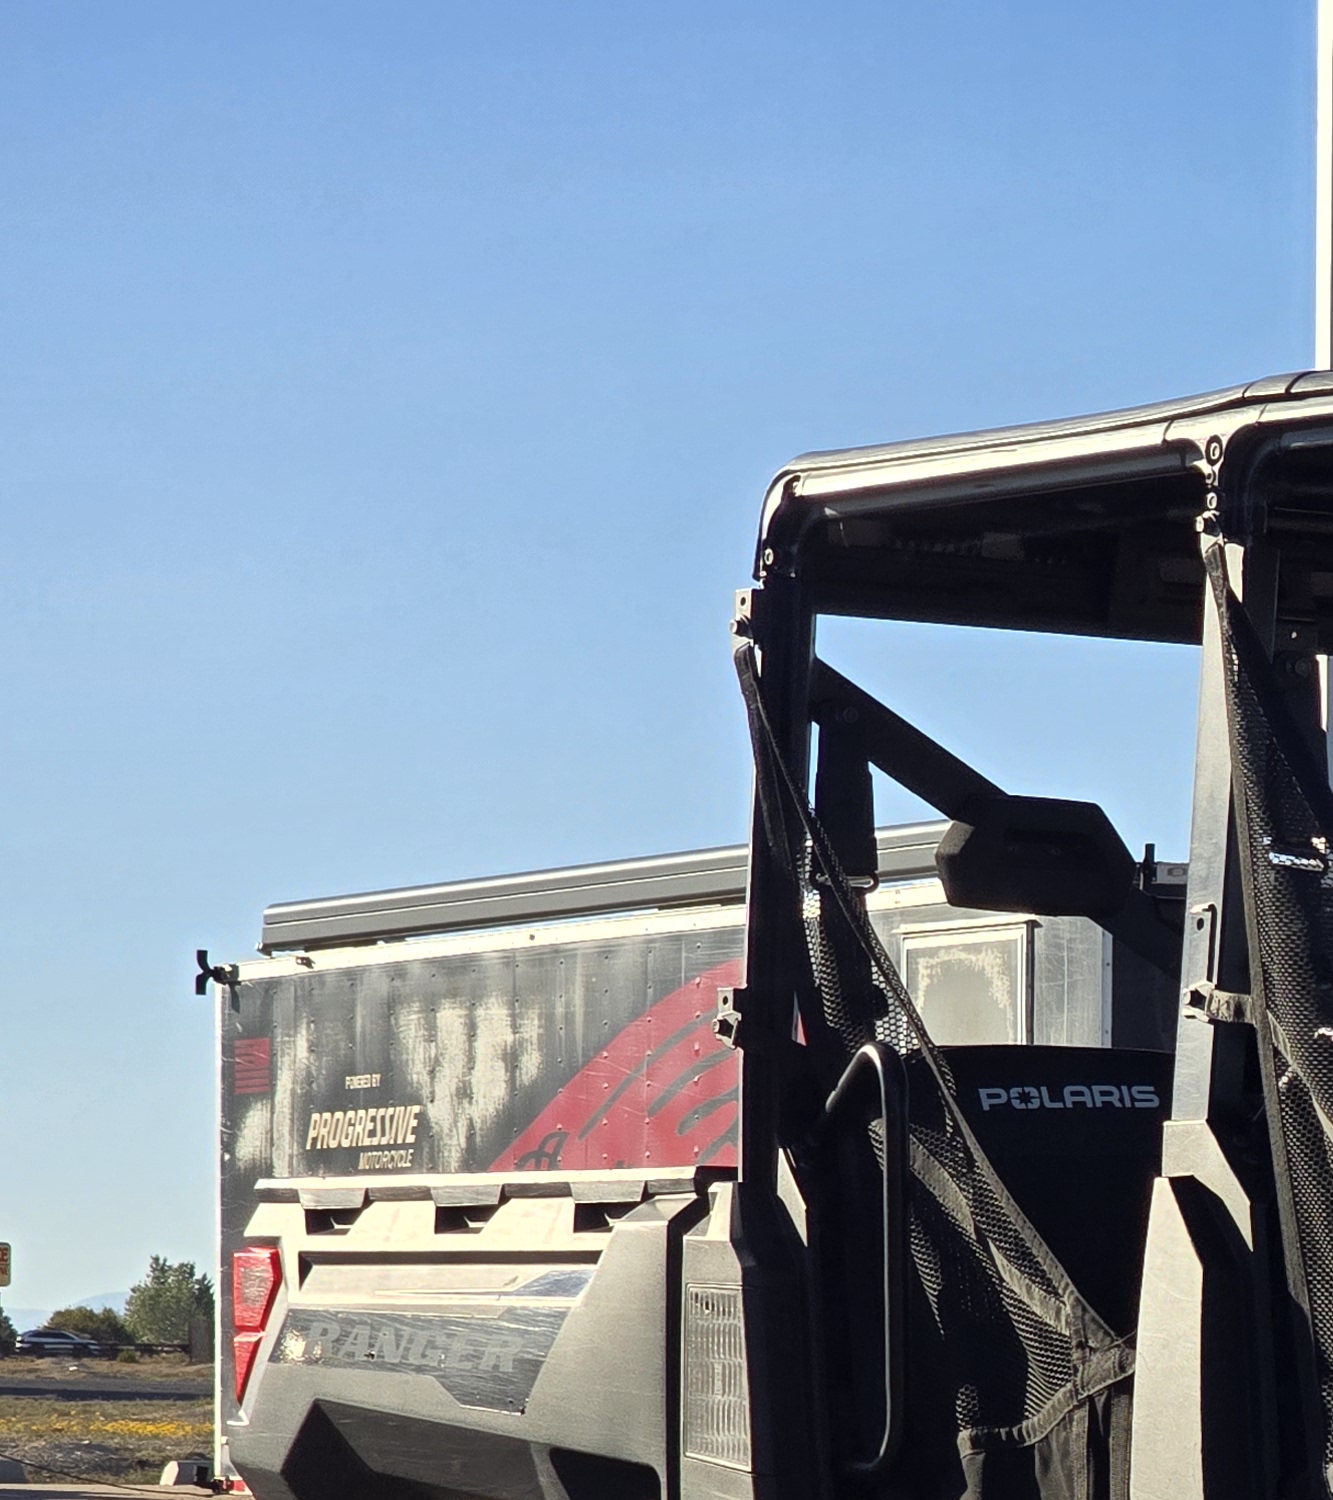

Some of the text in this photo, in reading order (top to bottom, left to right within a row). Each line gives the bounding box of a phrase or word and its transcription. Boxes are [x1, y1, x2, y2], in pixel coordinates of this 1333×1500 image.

[978, 1085, 1160, 1111] POLARIS
[306, 1105, 421, 1150] PROGRESSIVE
[358, 1149, 414, 1170] MOTORCYCLE
[305, 1321, 525, 1373] RANGER
